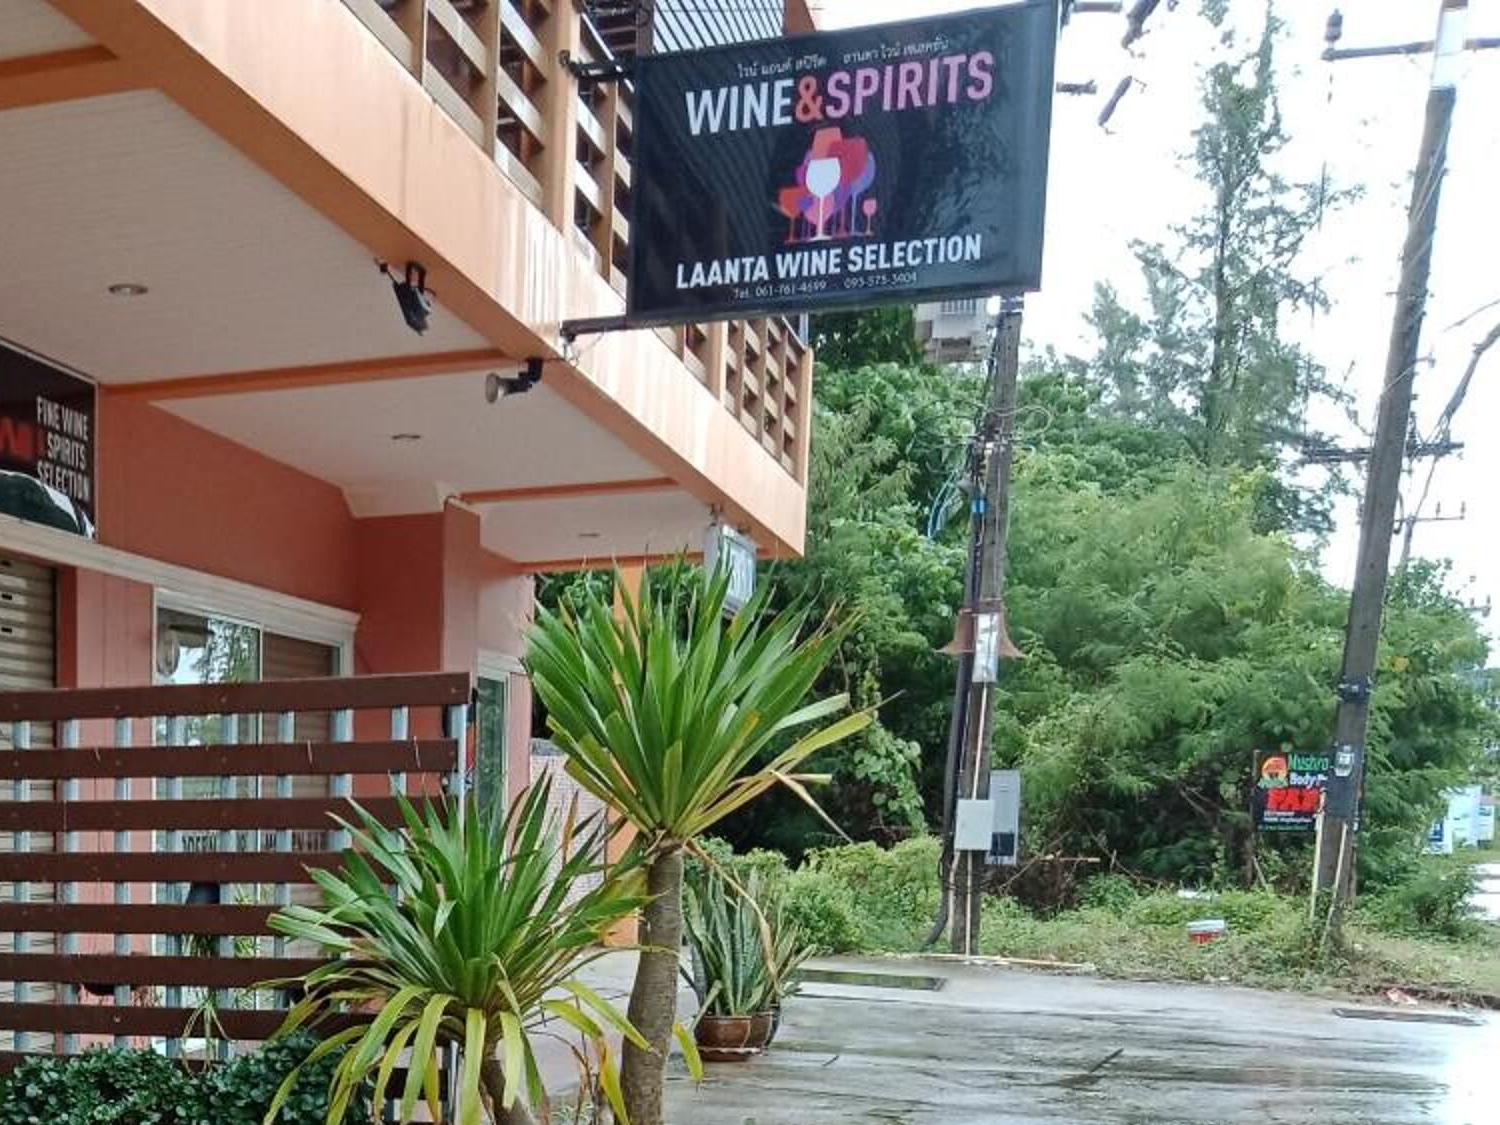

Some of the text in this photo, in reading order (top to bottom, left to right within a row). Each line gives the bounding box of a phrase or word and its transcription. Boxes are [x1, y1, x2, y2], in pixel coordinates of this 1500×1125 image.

[685, 51, 994, 136] WINE&SPIRITS
[675, 233, 982, 290] LAANTA WINE SELECTION
[37, 395, 88, 442] FINE WINE
[47, 431, 86, 471] SPIRITS
[37, 460, 89, 502] SELECTION
